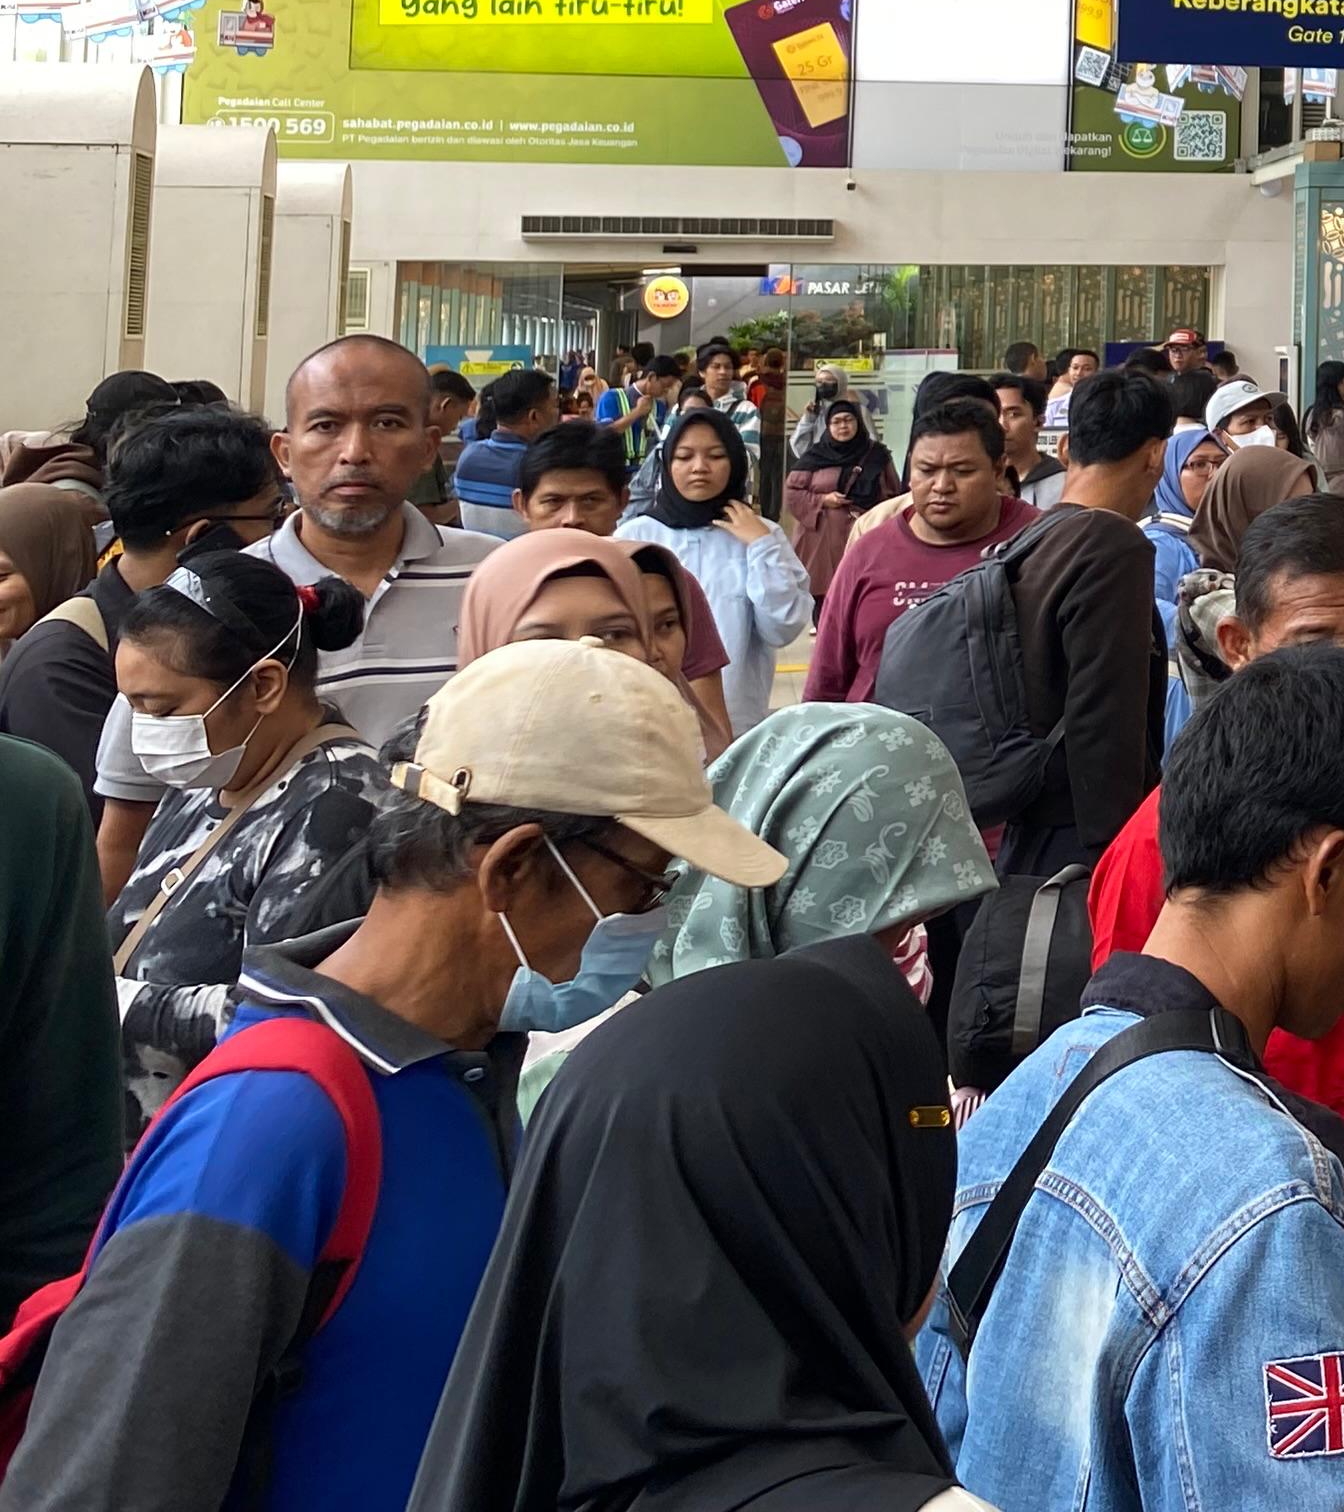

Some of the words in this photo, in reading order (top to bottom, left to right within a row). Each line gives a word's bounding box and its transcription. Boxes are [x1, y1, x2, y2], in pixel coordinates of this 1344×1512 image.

[1287, 25, 1334, 46] Gate
[217, 96, 271, 108] Pegadaian
[293, 98, 326, 109] Center
[285, 117, 327, 135] 569
[342, 117, 494, 132] sahabat.pegadaian.co.id
[509, 121, 635, 135] www.pegadaian.co.id
[807, 281, 850, 295] PASAR
